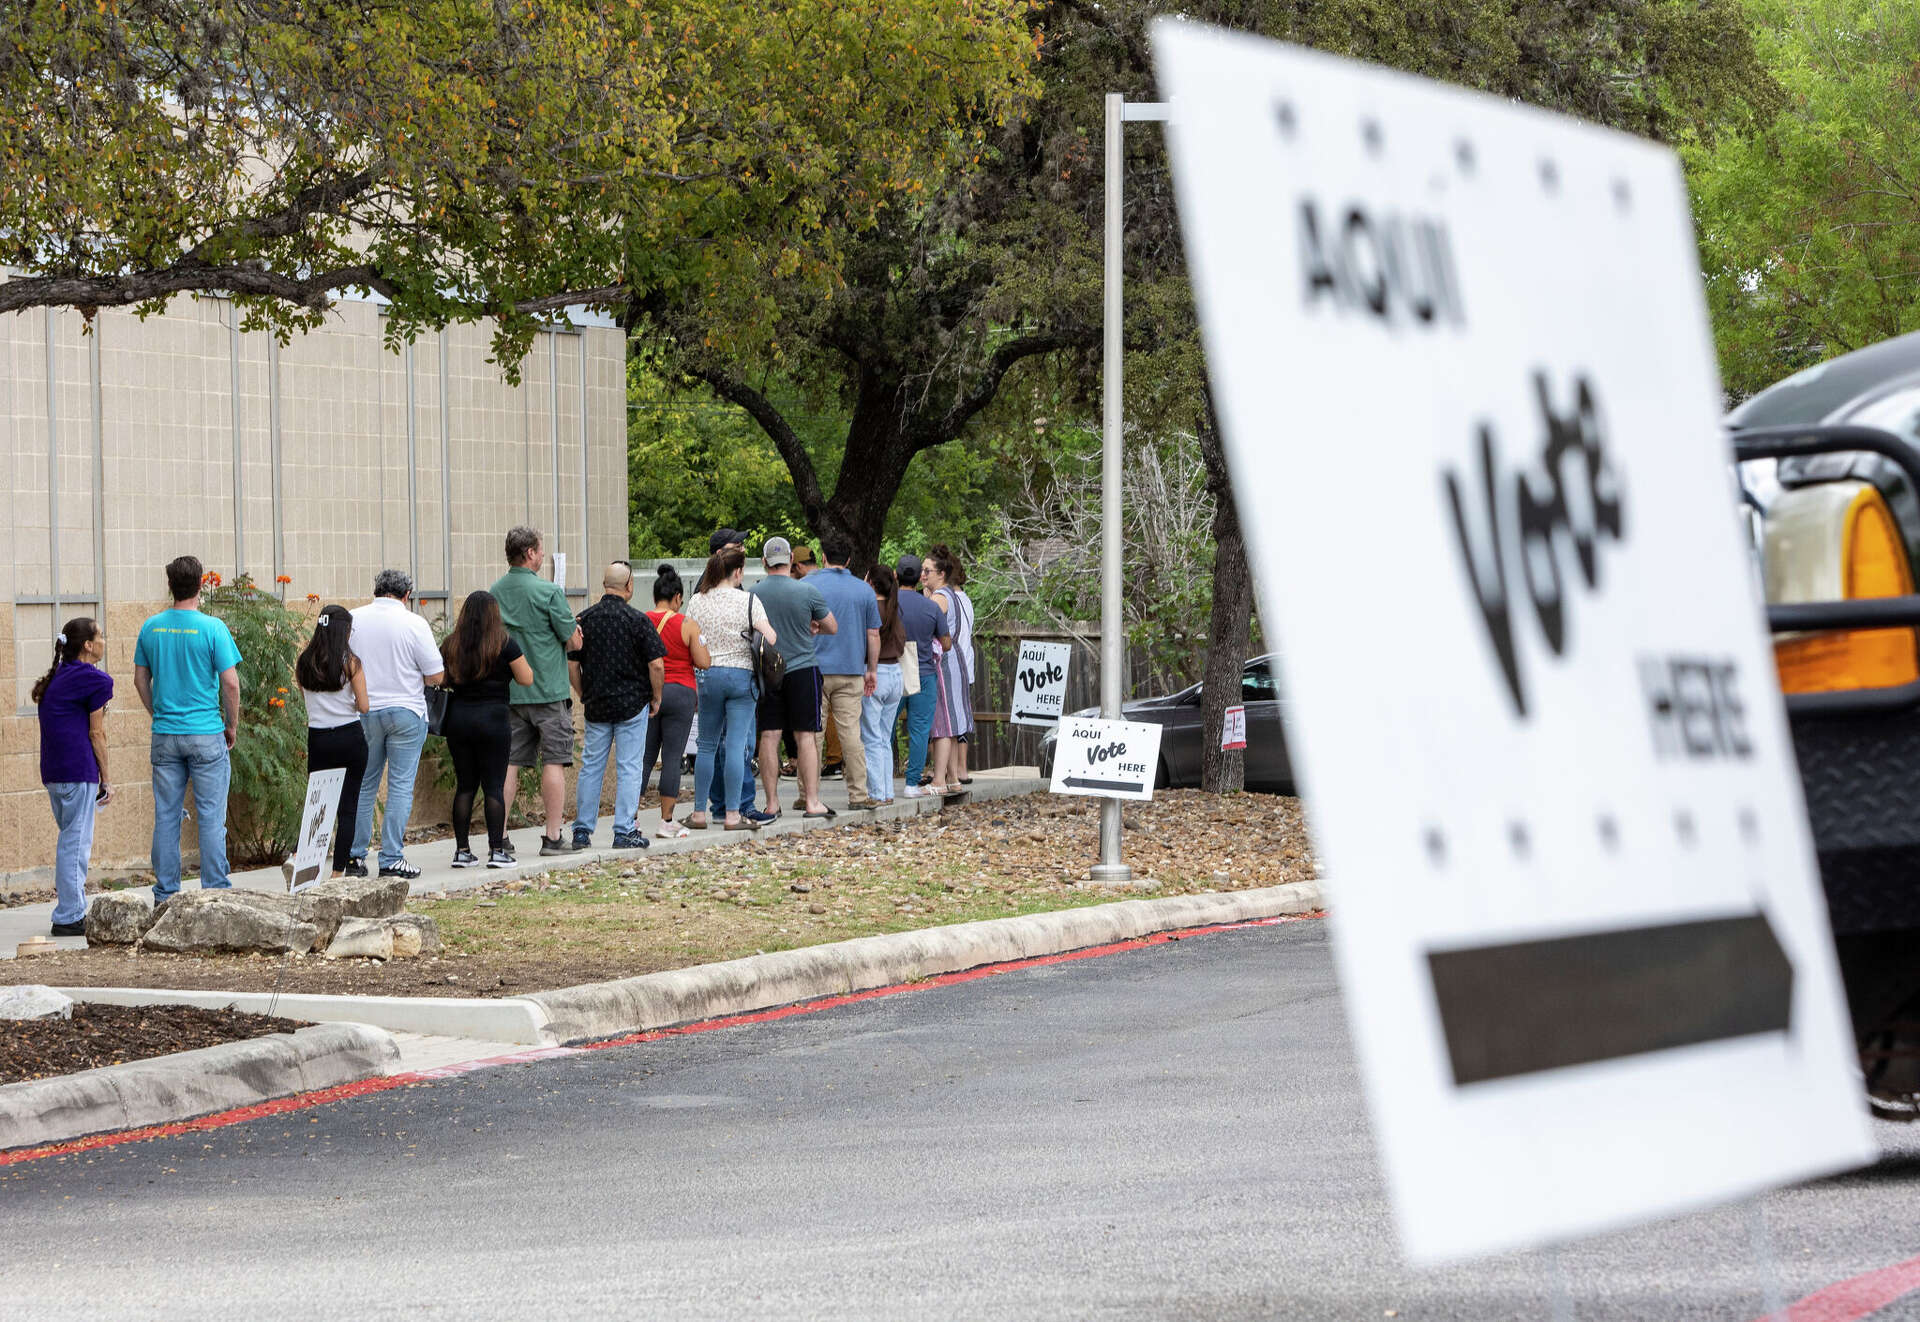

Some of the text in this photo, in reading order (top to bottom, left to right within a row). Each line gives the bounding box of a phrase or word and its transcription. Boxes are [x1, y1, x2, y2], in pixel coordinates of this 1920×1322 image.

[1019, 662, 1063, 693] Vote
[1036, 694, 1061, 705] HERE
[1087, 742, 1127, 766] Vote
[1118, 762, 1147, 773] HERE
